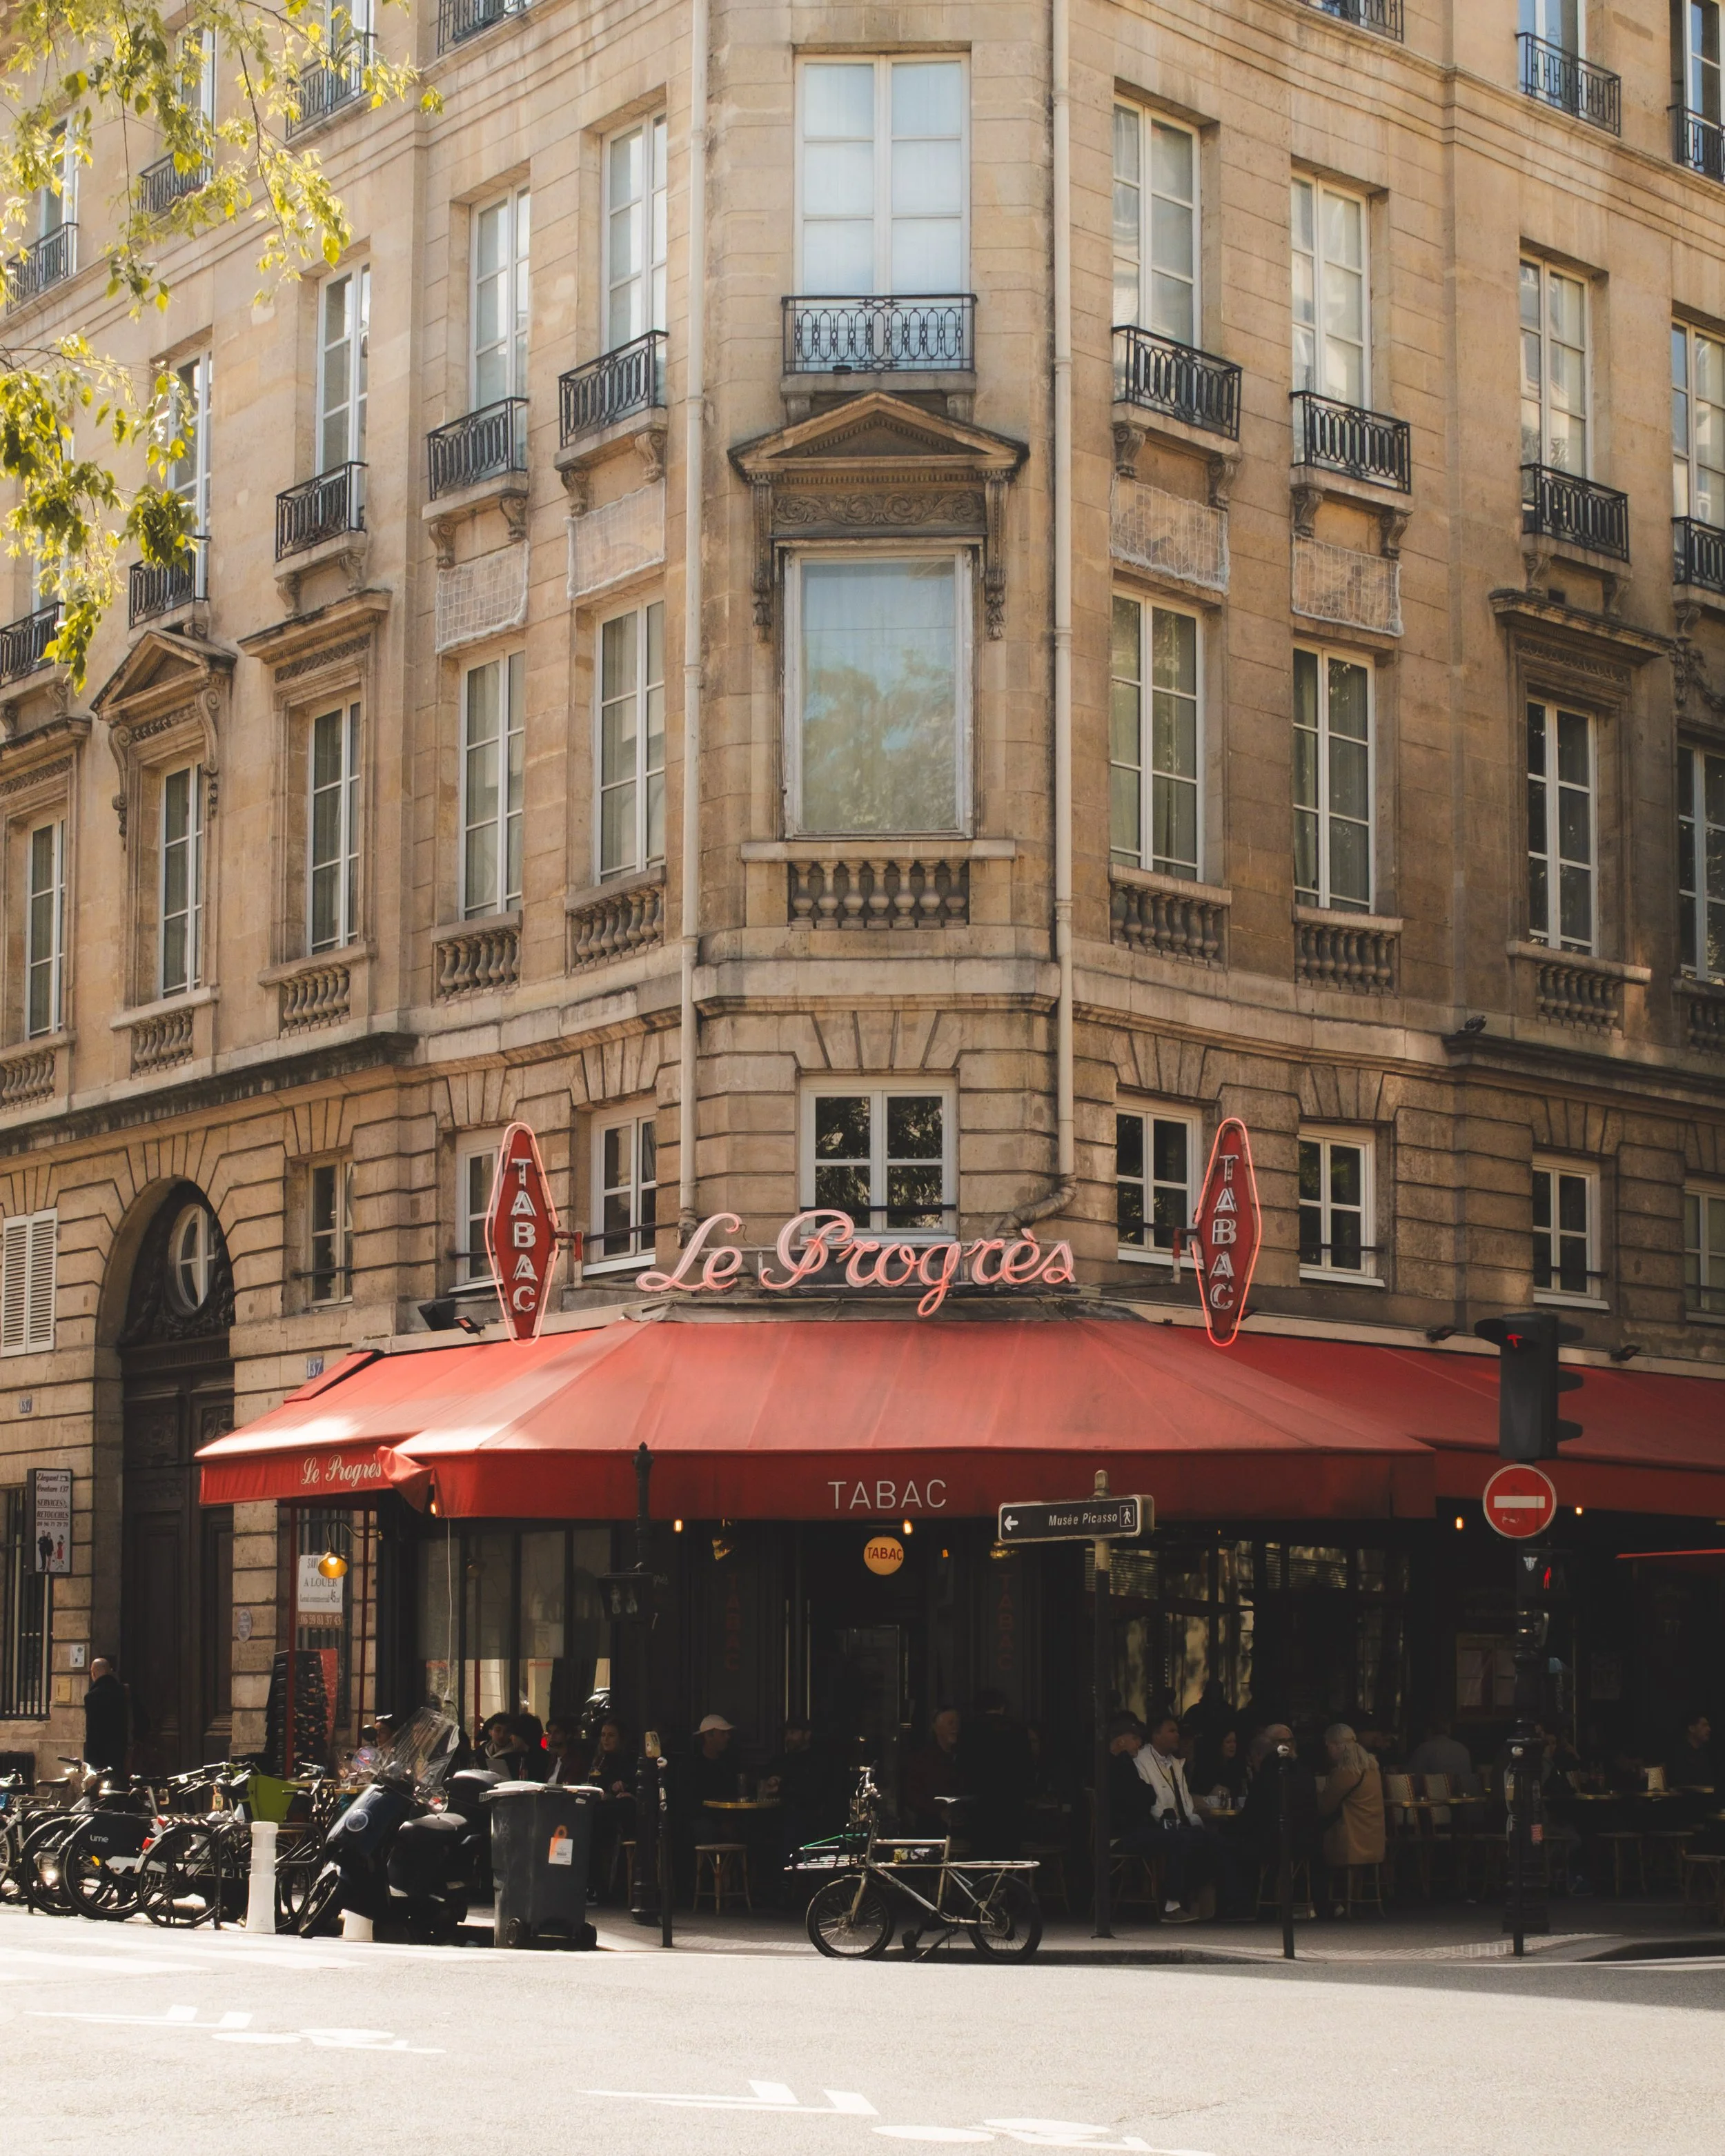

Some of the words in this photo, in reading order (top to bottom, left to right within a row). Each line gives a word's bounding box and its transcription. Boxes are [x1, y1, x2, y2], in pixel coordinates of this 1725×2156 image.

[511, 1158, 538, 1312] TABAC
[1209, 1154, 1239, 1310] TABAC
[635, 1212, 743, 1292] Le
[761, 1209, 1076, 1317] Progrès
[308, 1358, 323, 1377] 137
[300, 1457, 320, 1485] Le
[325, 1454, 382, 1487] Progrès
[827, 1479, 947, 1510] TABAC
[1048, 1514, 1078, 1526] Musée
[1082, 1512, 1118, 1524] Picasso
[867, 1547, 903, 1561] TABAC
[310, 1577, 337, 1587] LOUER
[997, 1573, 1014, 1670] TABAC
